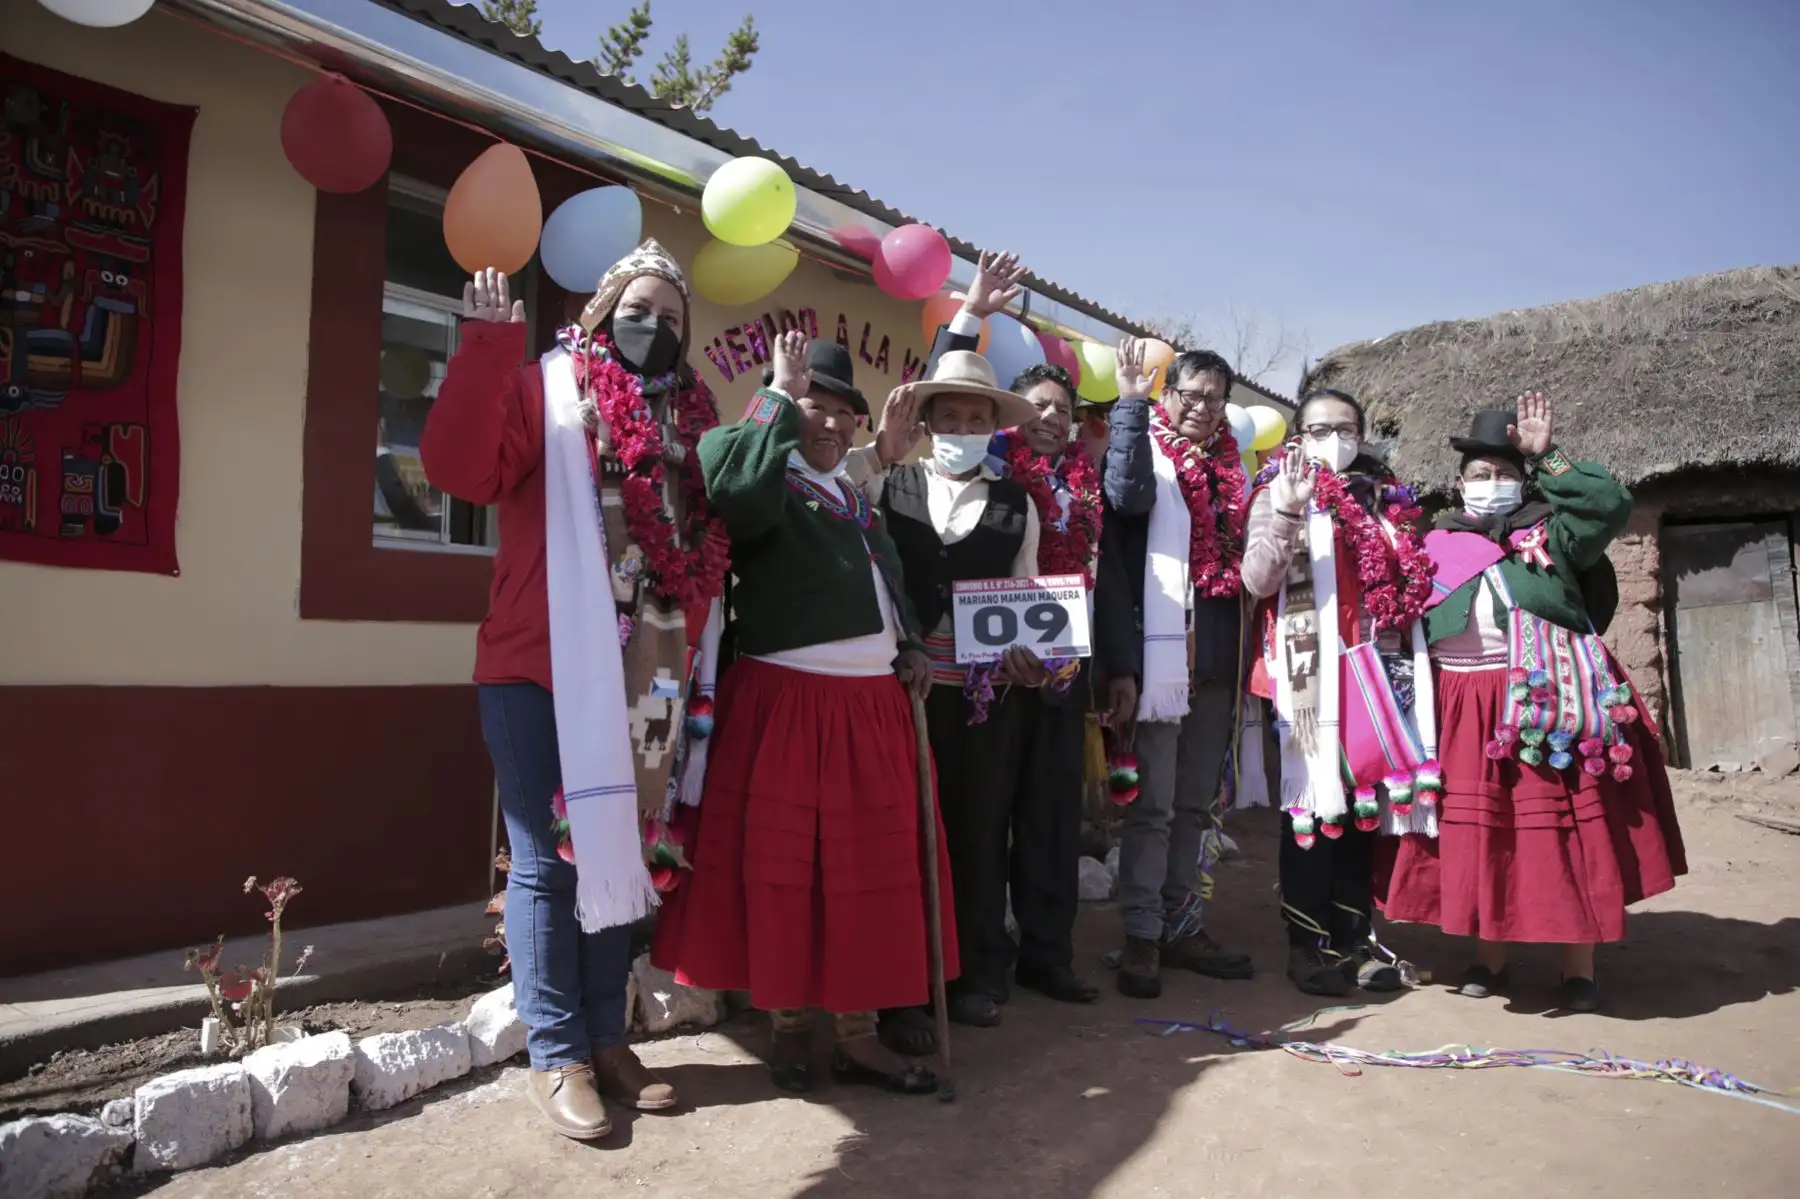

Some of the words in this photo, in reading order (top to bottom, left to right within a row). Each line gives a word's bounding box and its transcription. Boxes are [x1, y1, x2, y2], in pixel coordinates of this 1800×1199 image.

[836, 313, 850, 350] A
[858, 321, 890, 374] LA
[958, 594, 999, 605] MARIANO
[1000, 592, 1036, 604] MAMANI
[1038, 590, 1080, 601] MAQUERA
[972, 602, 1069, 646] 09
